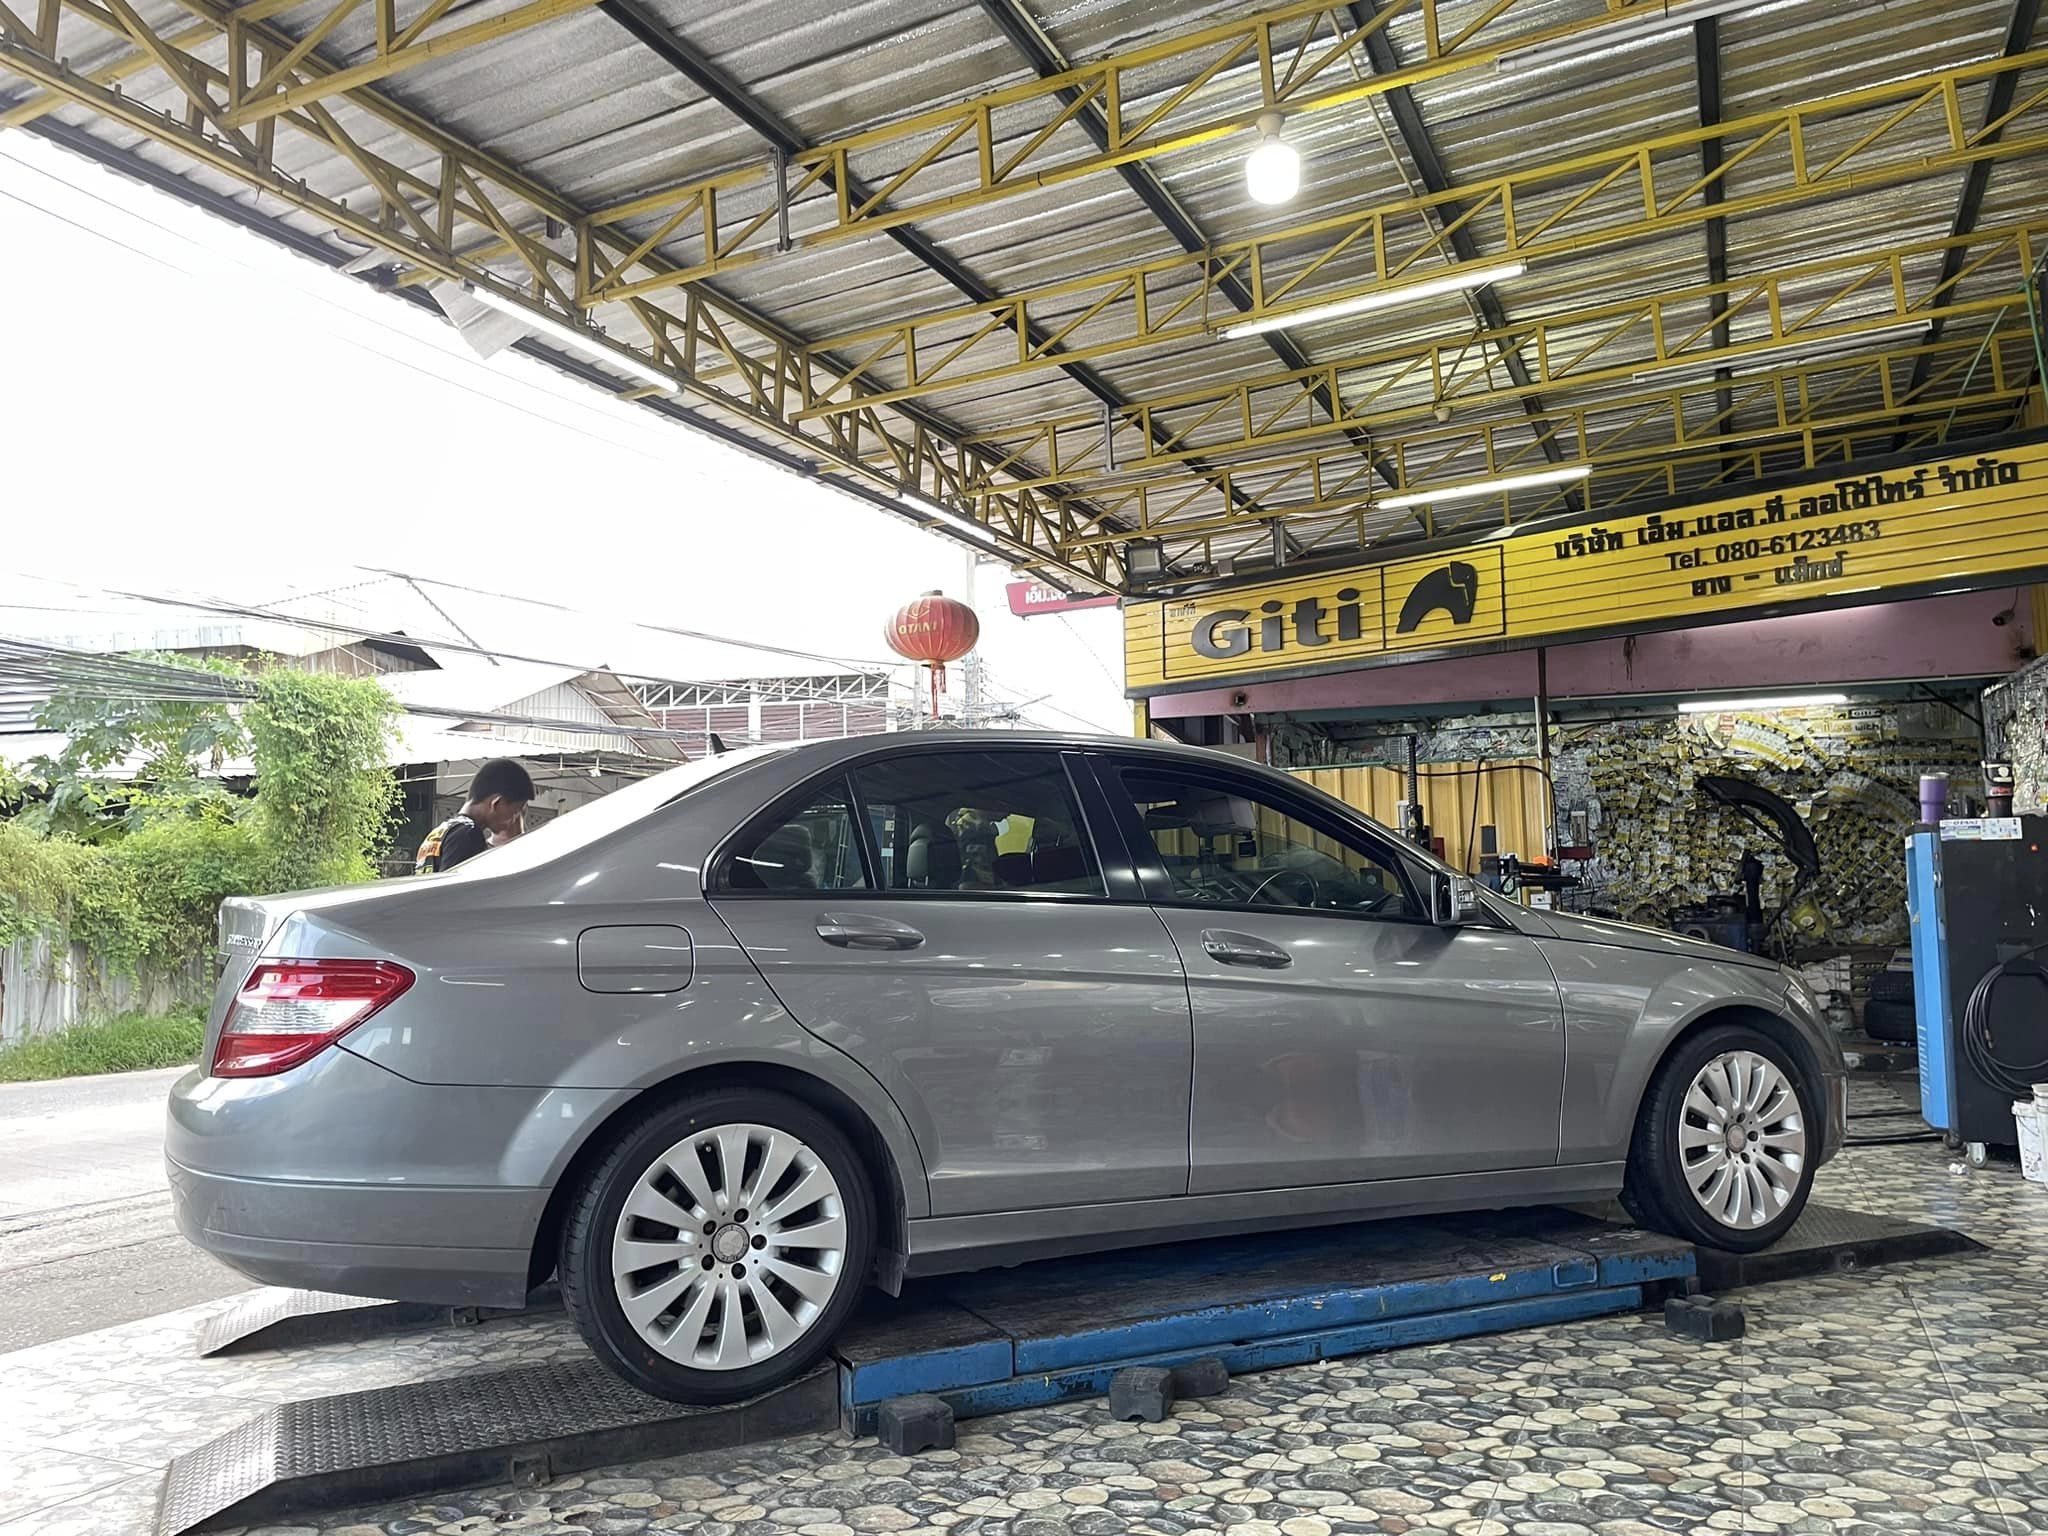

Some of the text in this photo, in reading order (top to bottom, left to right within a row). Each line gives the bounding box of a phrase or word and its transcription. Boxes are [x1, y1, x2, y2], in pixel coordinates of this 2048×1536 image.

[1554, 527, 1624, 560] บริษัท
[1937, 458, 2020, 494] จำกัด
[1665, 519, 1881, 571] Tel. 080-6123483
[1691, 575, 1731, 597] ยาง
[898, 621, 938, 634] OTANI
[1191, 587, 1360, 659] Giti
